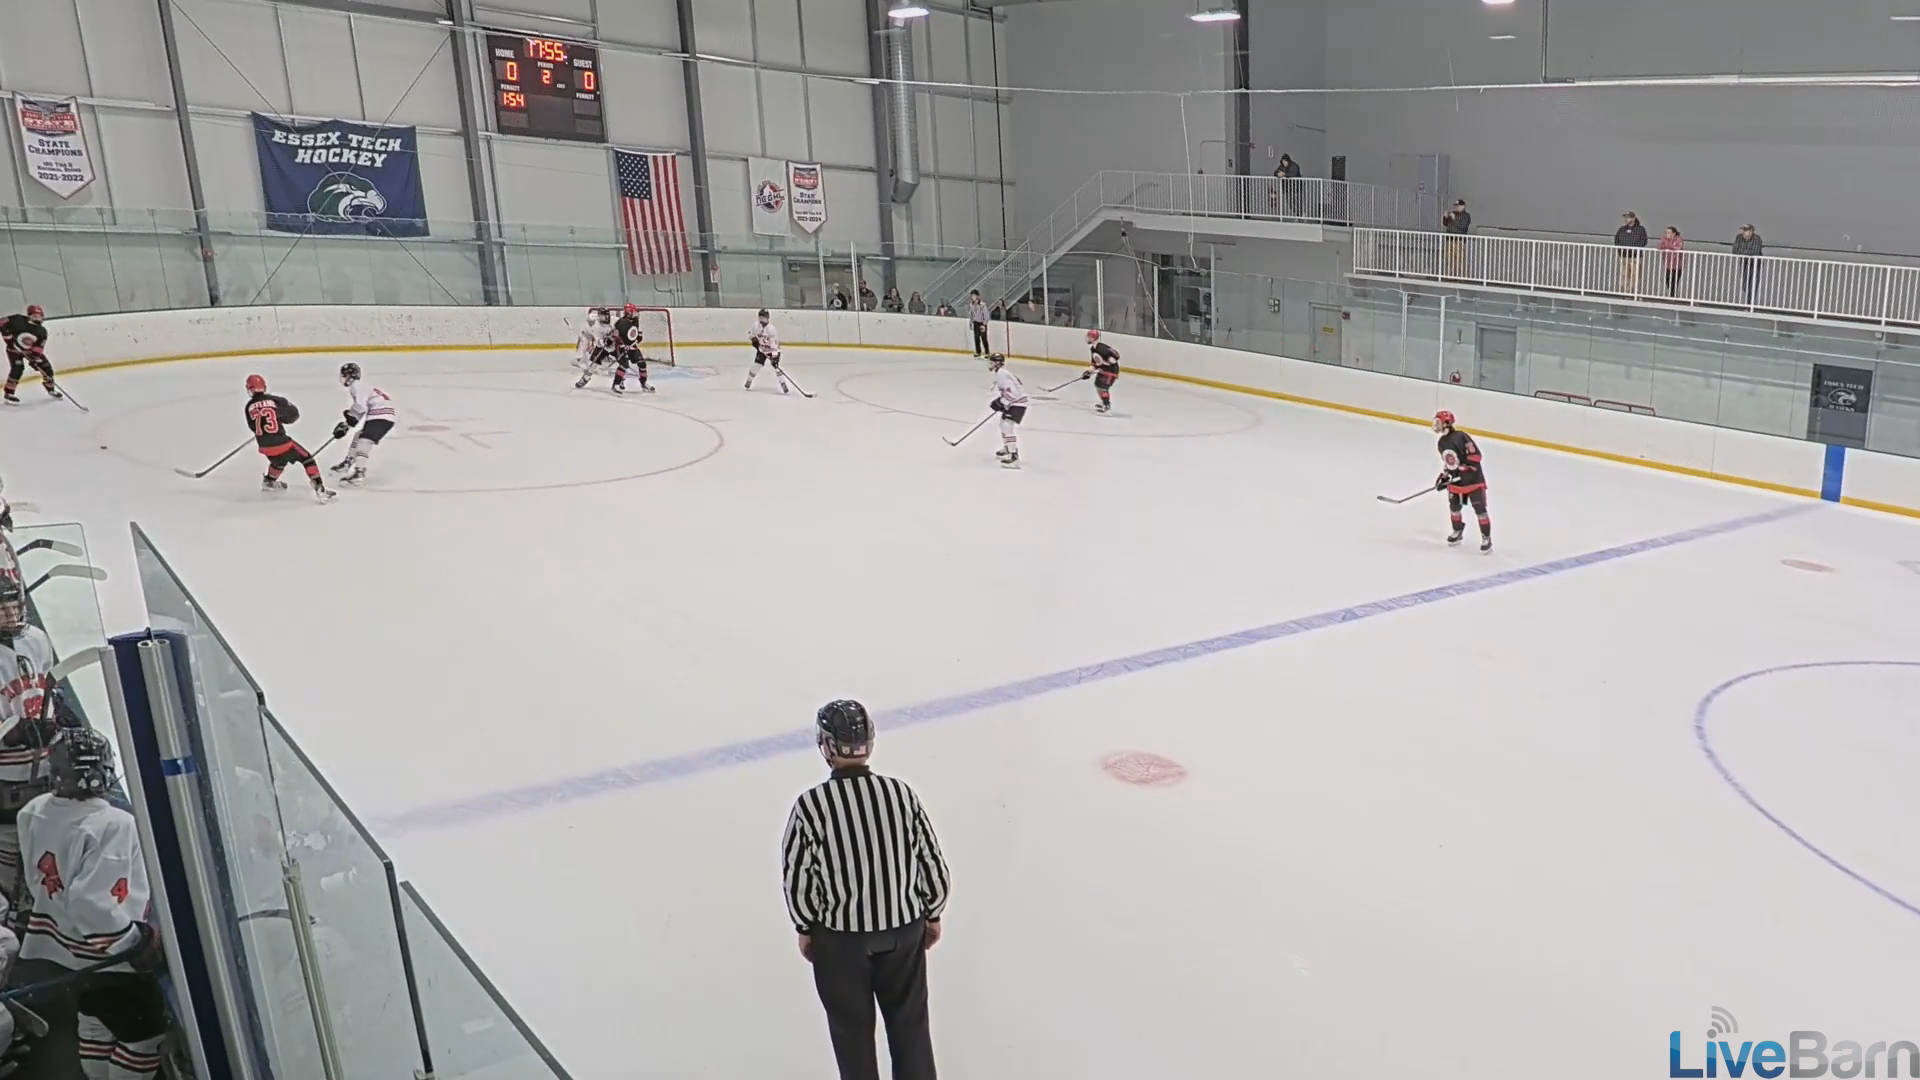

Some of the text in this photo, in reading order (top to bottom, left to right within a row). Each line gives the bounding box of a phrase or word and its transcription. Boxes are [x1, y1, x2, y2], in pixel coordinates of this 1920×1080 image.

[495, 48, 515, 59] HOME
[528, 39, 564, 62] 17:55
[506, 61, 517, 81] 0
[537, 61, 554, 69] PERIOD
[573, 58, 592, 69] GUEST
[542, 69, 551, 84] 2
[584, 71, 594, 90] 0
[500, 83, 520, 91] PENALTY
[503, 92, 524, 107] 1:54
[575, 92, 594, 100] PENALTY
[38, 138, 70, 148] STATE
[272, 129, 402, 151] ESSEX TECH
[28, 145, 83, 157] CHAMPIONS
[294, 147, 387, 168] HOCKEY
[37, 172, 85, 182] 2021-2022
[249, 407, 279, 436] 73
[110, 877, 128, 903] 4
